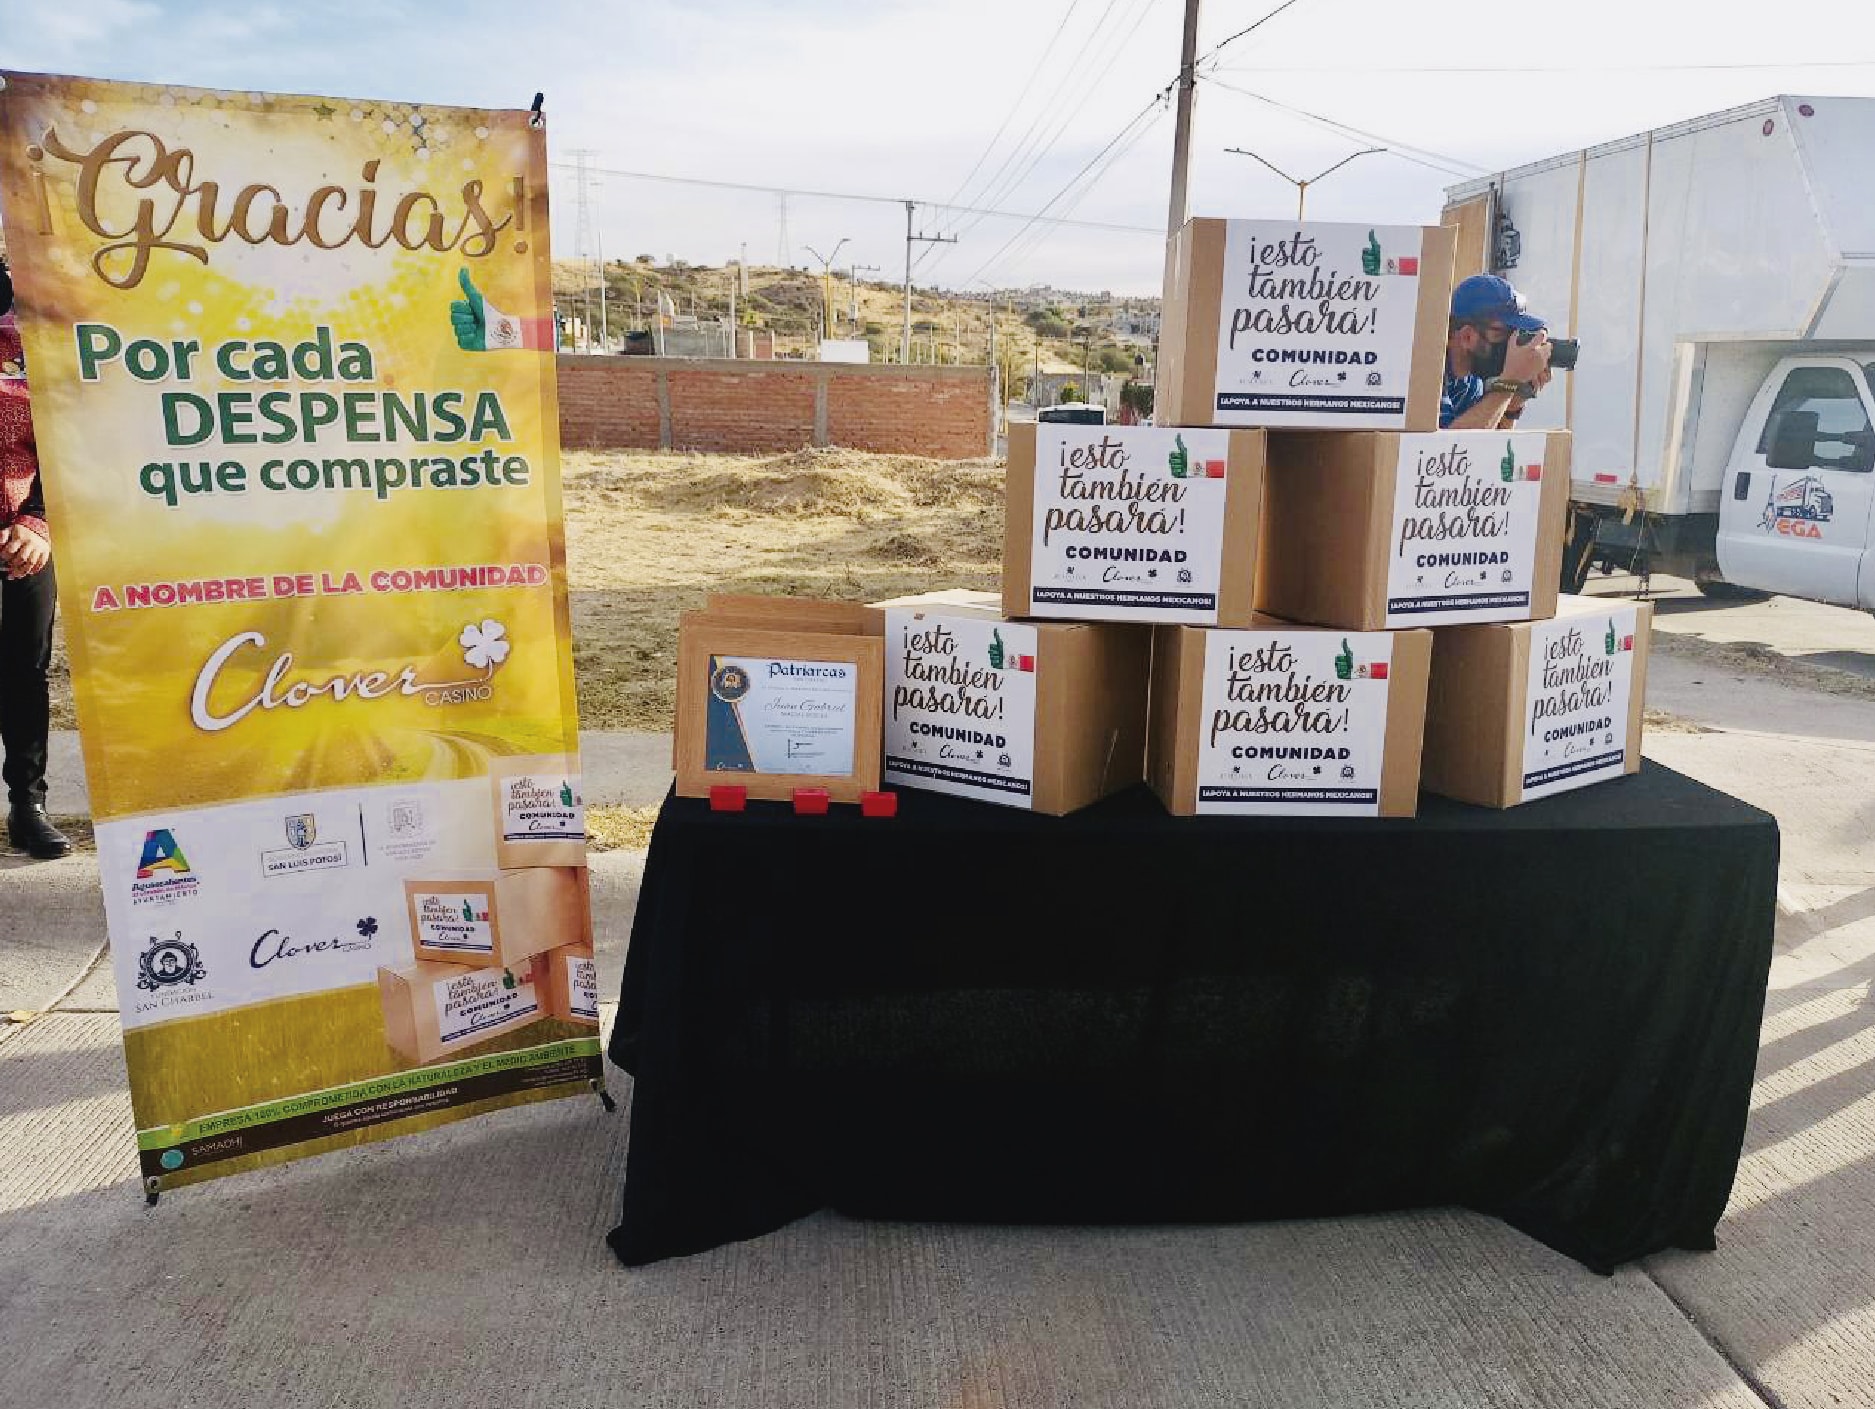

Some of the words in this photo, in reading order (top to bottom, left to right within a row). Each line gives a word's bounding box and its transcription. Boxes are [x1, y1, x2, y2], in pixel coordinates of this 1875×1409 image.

[26, 125, 529, 289] ¡Gracias!
[1250, 232, 1322, 266] ¡esto
[1248, 264, 1380, 300] también
[1230, 300, 1377, 349] pasará!
[76, 325, 199, 380] Por
[217, 327, 374, 380] cada
[1252, 349, 1378, 365] COMUNIDAD
[162, 392, 512, 444] DESPENSA
[1061, 435, 1131, 469] ¡esto
[1417, 443, 1471, 478] ¡esto
[140, 458, 246, 506] que
[260, 450, 529, 498] compraste
[1059, 467, 1187, 502] también
[1414, 475, 1511, 508] también
[1043, 502, 1185, 547] pasará!
[1399, 506, 1509, 558] pasará!
[1777, 518, 1823, 539] EGA
[1066, 546, 1187, 563] COMUNIDAD
[1416, 551, 1509, 568] COMUNIDAD
[93, 587, 119, 611] A
[126, 577, 266, 608] NOMBRE
[273, 574, 314, 598] DE
[322, 572, 362, 594] LA
[371, 564, 547, 592] COMUNIDAD
[1074, 593, 1115, 601] NUESTROS
[1116, 595, 1160, 603] HERMANOS
[1162, 596, 1212, 605] MEXICANOS!
[903, 624, 959, 655] ¡esto
[1229, 640, 1298, 672] ¡esto
[1544, 627, 1584, 661] ¡esto
[191, 631, 422, 731] Clover
[767, 662, 846, 678] Patriarcas
[903, 650, 1003, 691] también
[1227, 671, 1351, 703] también
[1543, 654, 1614, 689] también
[425, 686, 493, 706] CASINO
[894, 684, 1003, 721] pasará!
[1532, 681, 1612, 736] pasará!
[910, 721, 1006, 749] COMUNIDAD
[1210, 702, 1349, 748] pasará!
[1544, 716, 1611, 743] COMUNIDAD
[1231, 746, 1350, 760] COMUNIDAD
[250, 929, 342, 968] Clover
[200, 1115, 252, 1133] EMPRESA
[283, 1087, 368, 1114] COMPROMETIDA
[368, 1082, 392, 1096] CON
[393, 1079, 407, 1090] LA
[408, 1067, 474, 1089] NATURALEZA
[482, 1061, 496, 1071] EL
[322, 1110, 352, 1123] JUEGA
[354, 1105, 375, 1116] CON
[376, 1087, 458, 1111] RESPONSABILIDAD
